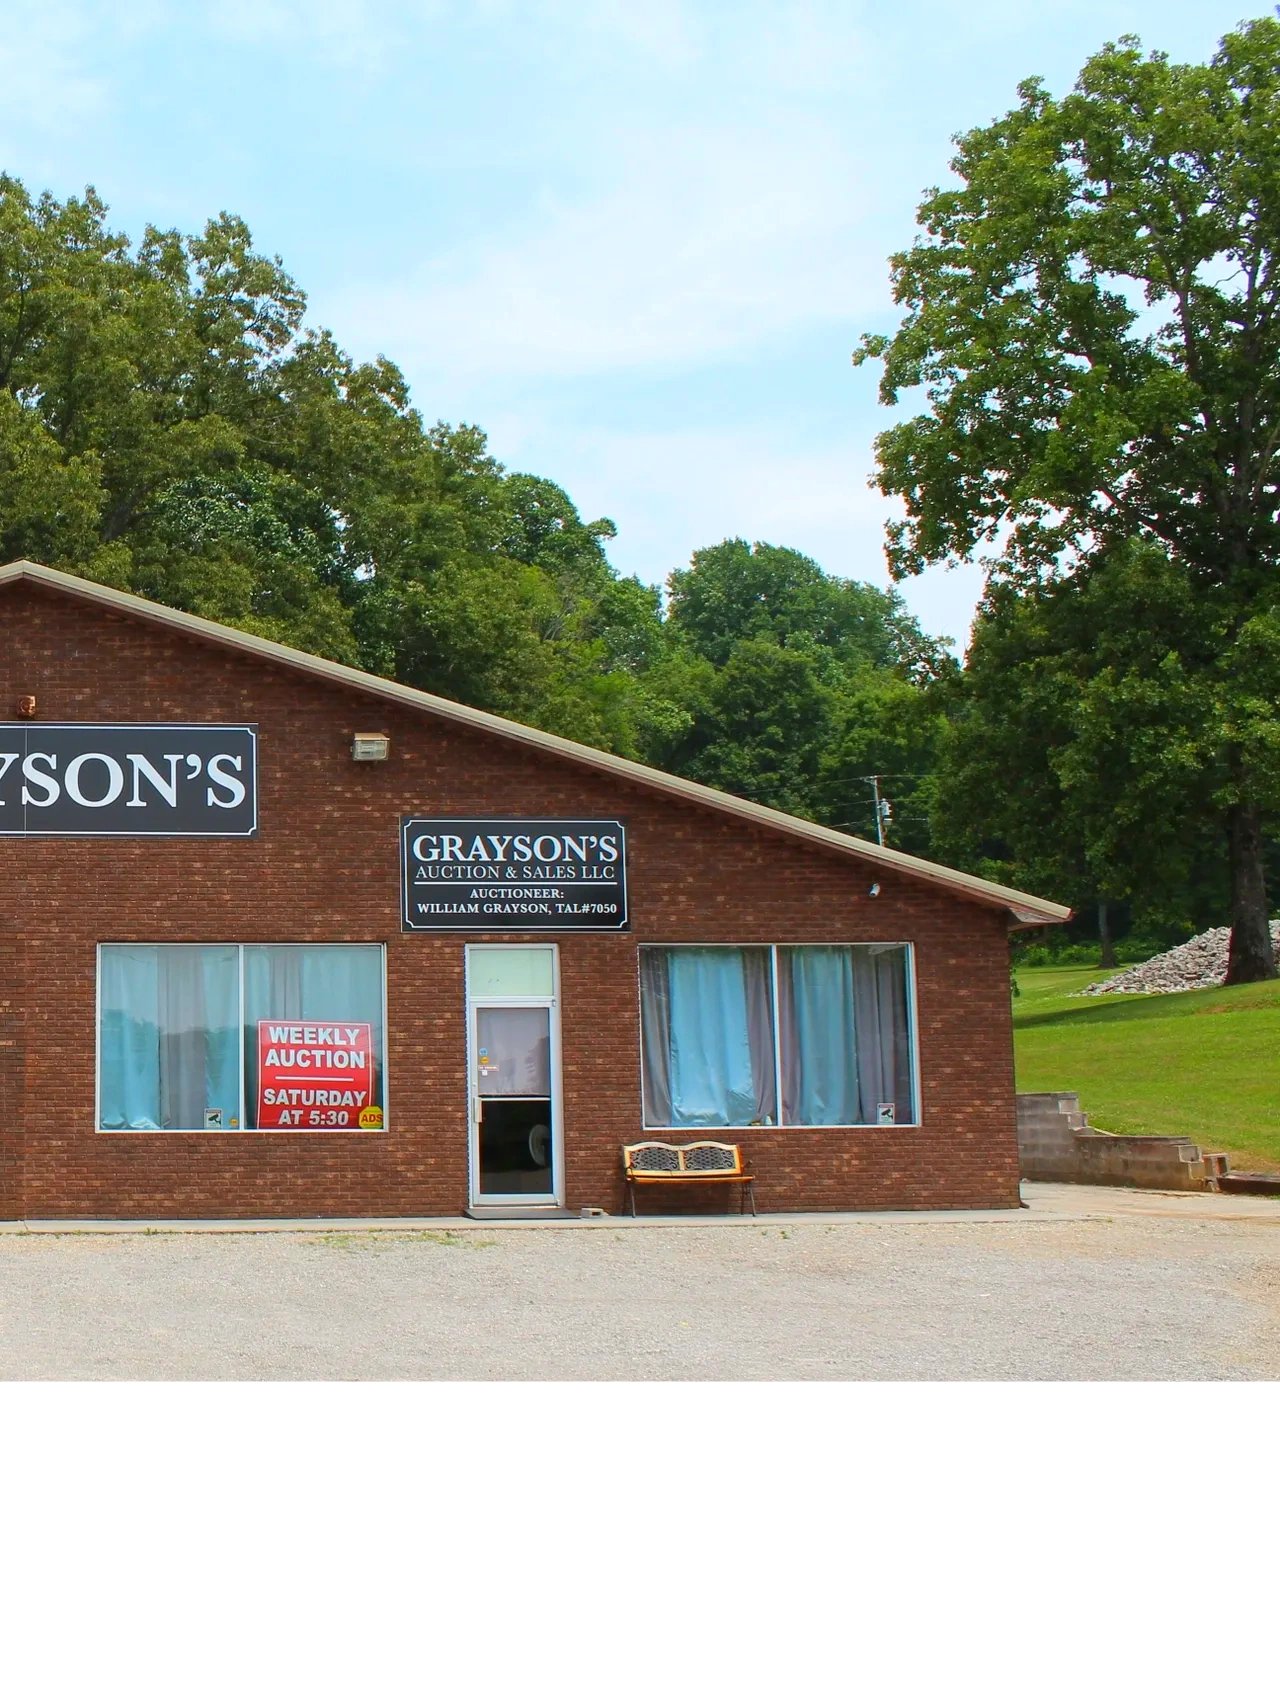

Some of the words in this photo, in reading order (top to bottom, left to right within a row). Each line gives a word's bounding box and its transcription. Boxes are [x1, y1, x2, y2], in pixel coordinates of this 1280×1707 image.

[412, 834, 619, 862] GRAYSON'S
[415, 864, 500, 879] AUCTION
[505, 865, 518, 879] &
[522, 865, 576, 879] SALES
[581, 866, 615, 879] LLC
[469, 888, 565, 899] AUCTIONEER:
[417, 903, 480, 914] WILLIAM
[482, 903, 552, 916] GRAYSON,
[555, 903, 618, 914] TAL#7050
[269, 1026, 360, 1046] WEEKLY
[265, 1049, 365, 1069] AUCTION
[263, 1088, 367, 1107] SATURDAY
[278, 1110, 304, 1124] AT
[308, 1110, 349, 1126] 5:30
[361, 1114, 383, 1123] ADS
